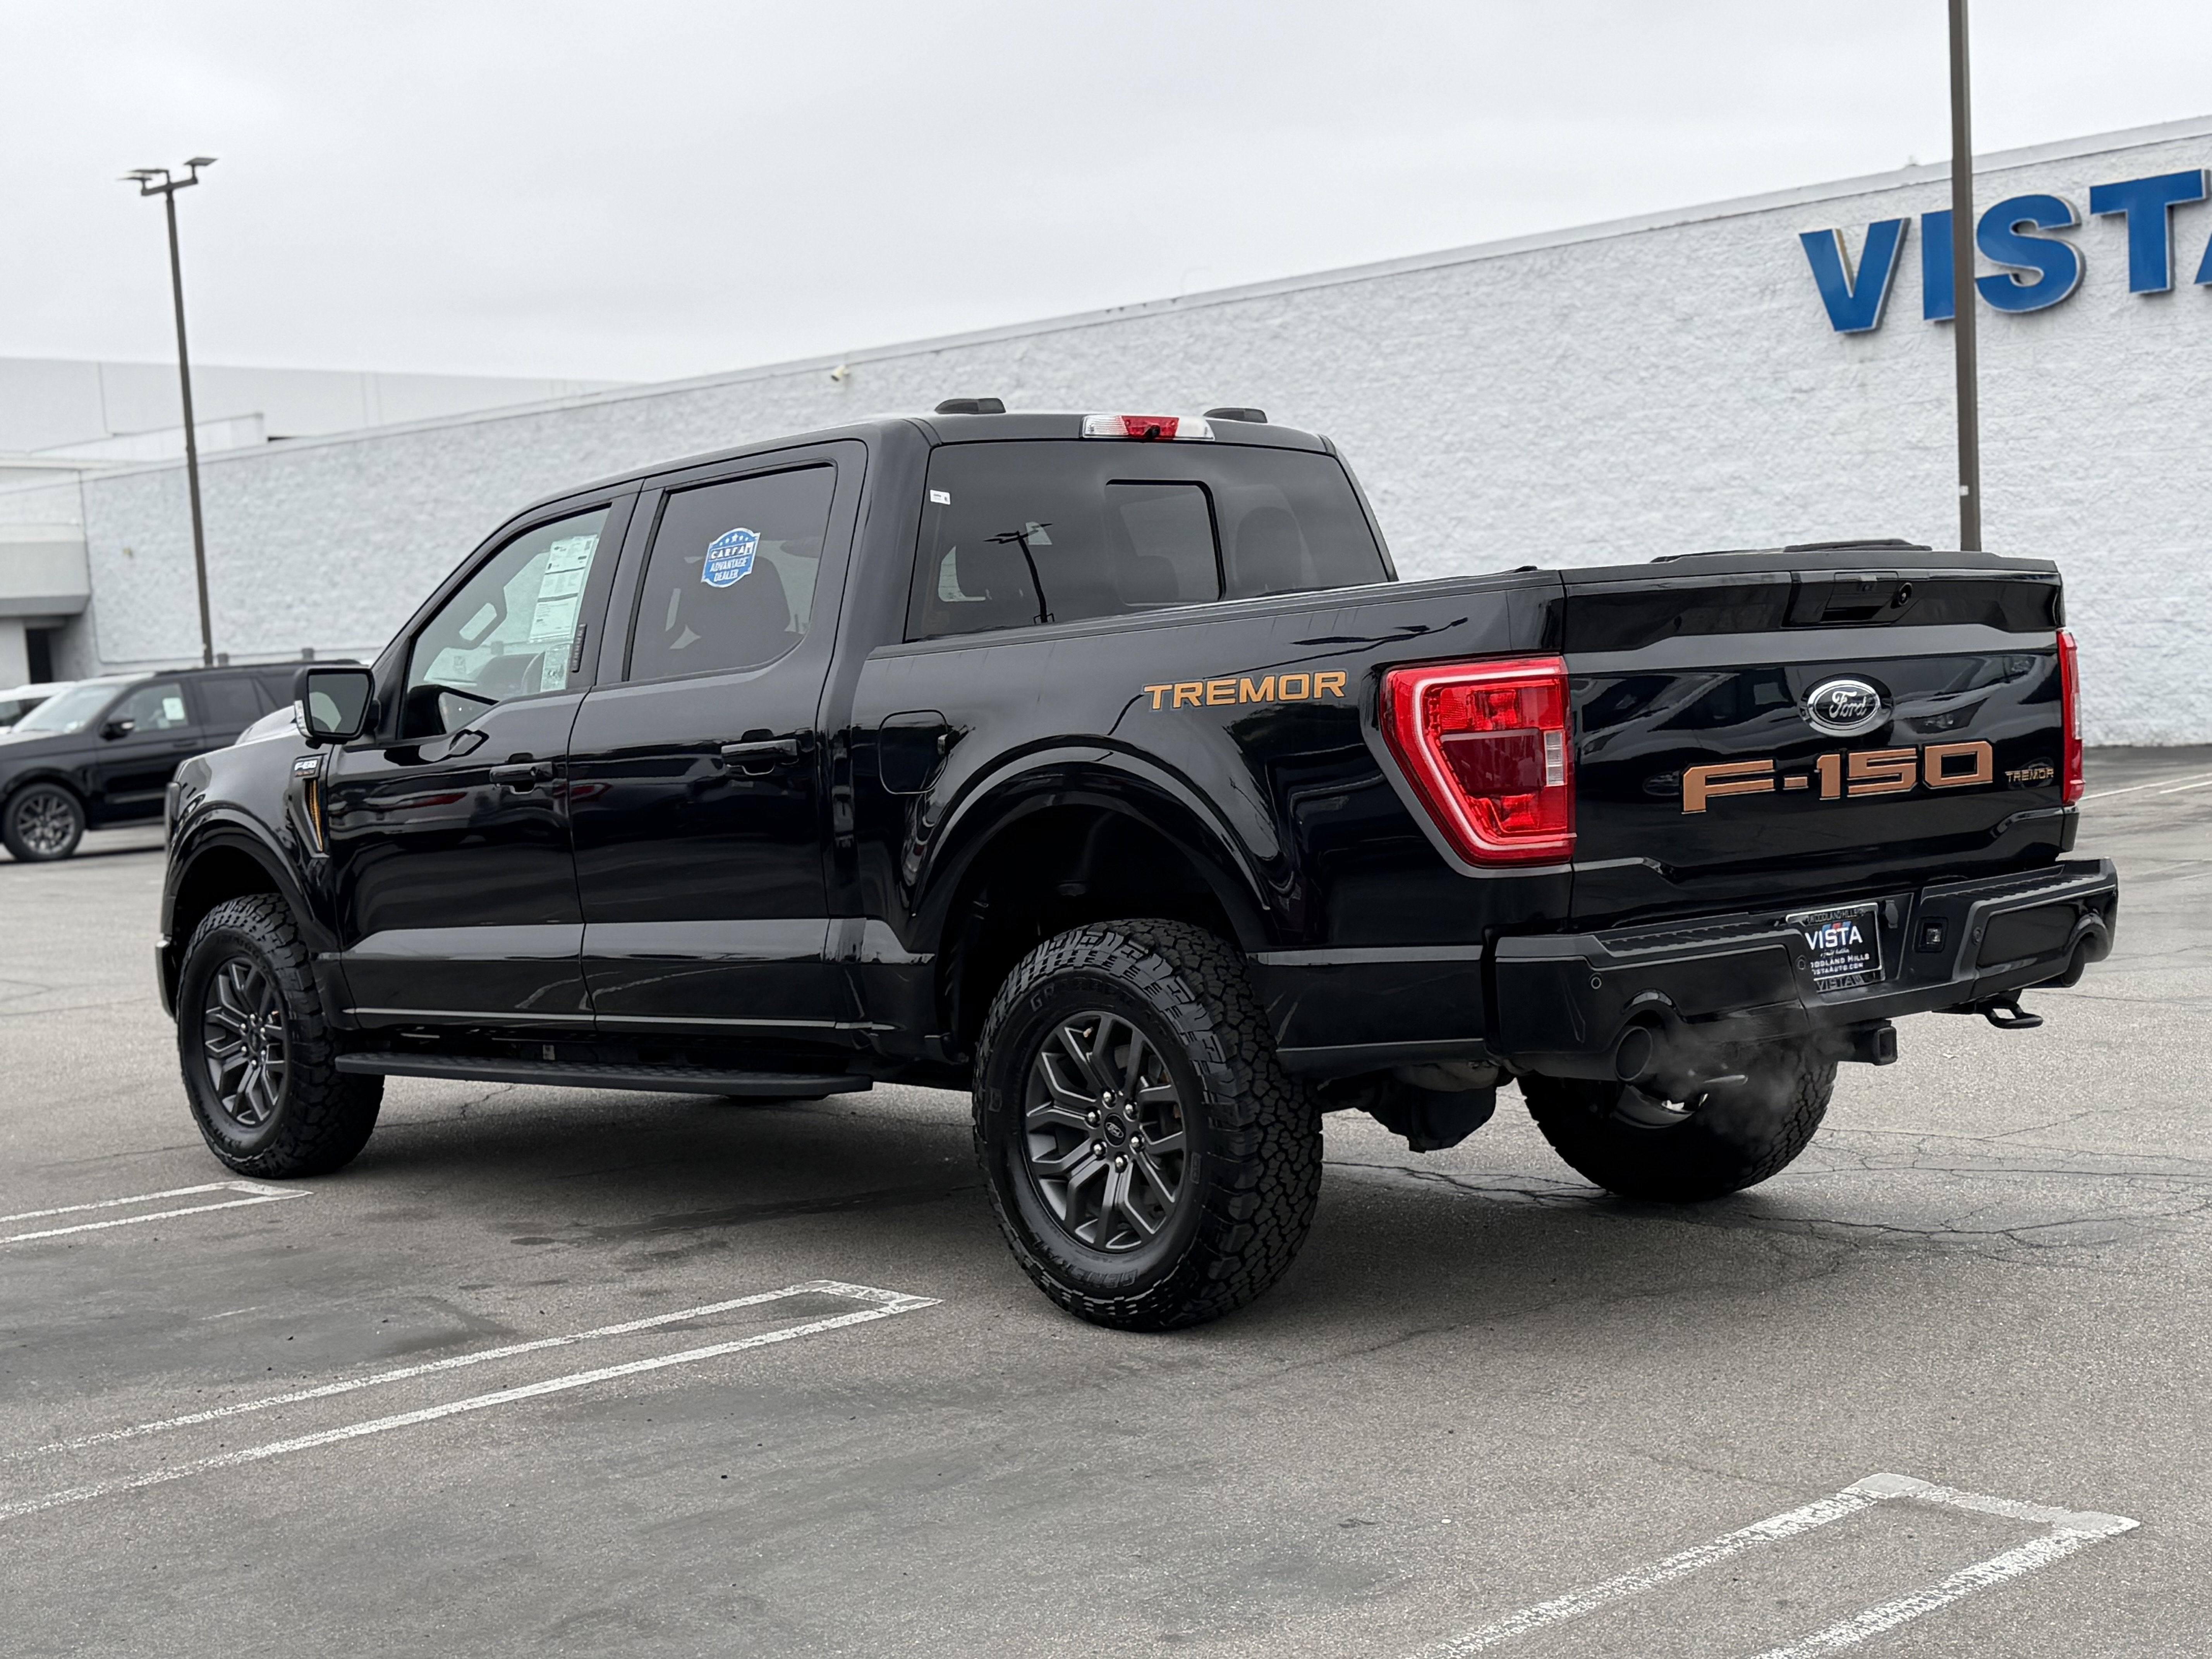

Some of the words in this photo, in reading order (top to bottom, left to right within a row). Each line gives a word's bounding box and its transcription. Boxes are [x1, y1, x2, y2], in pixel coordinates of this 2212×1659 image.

[1799, 168, 2212, 333] VIST
[709, 557, 748, 572] ADVANTAGE
[714, 570, 738, 582] DEALER
[1144, 670, 1346, 709] TREMOR
[1829, 690, 1867, 718] Ford
[1682, 740, 1994, 814] F-150
[2005, 767, 2054, 783] TREMOR
[1805, 926, 1863, 950] VISTA
[1848, 953, 1870, 962] HILLS
